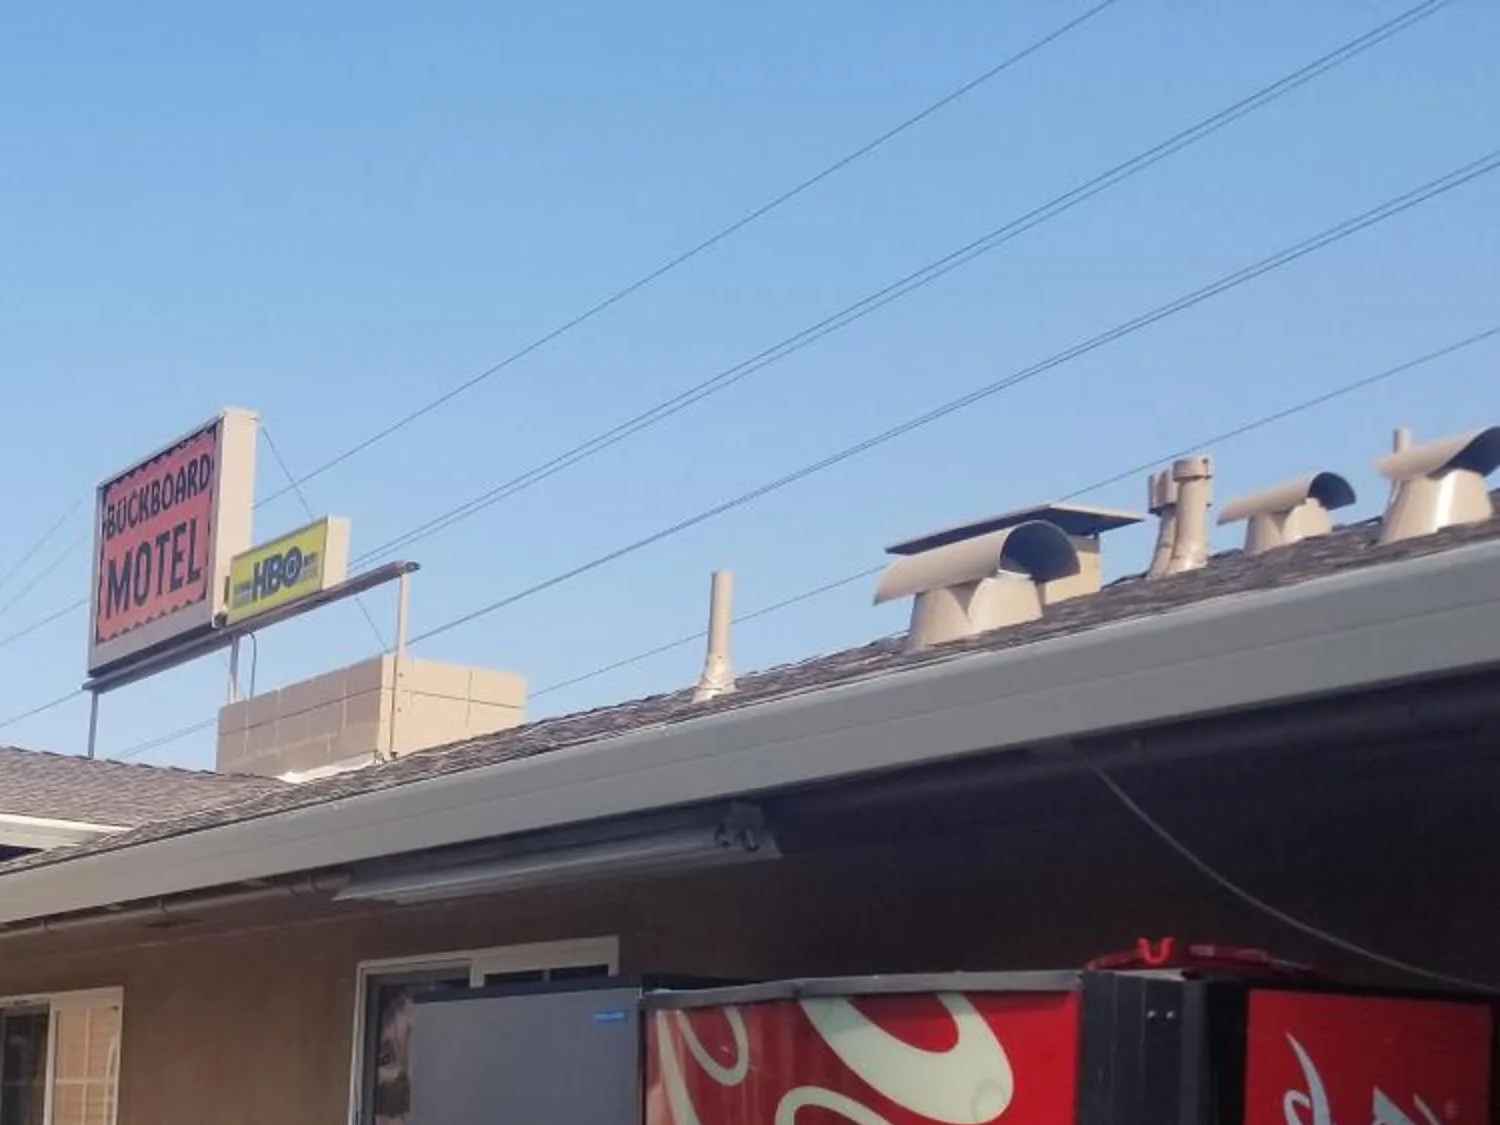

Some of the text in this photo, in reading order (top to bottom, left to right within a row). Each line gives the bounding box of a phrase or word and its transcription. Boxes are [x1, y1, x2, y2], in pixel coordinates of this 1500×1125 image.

[106, 453, 212, 541] BUCKBOARD
[105, 517, 201, 619] MOTEL
[251, 545, 303, 603] HBO
